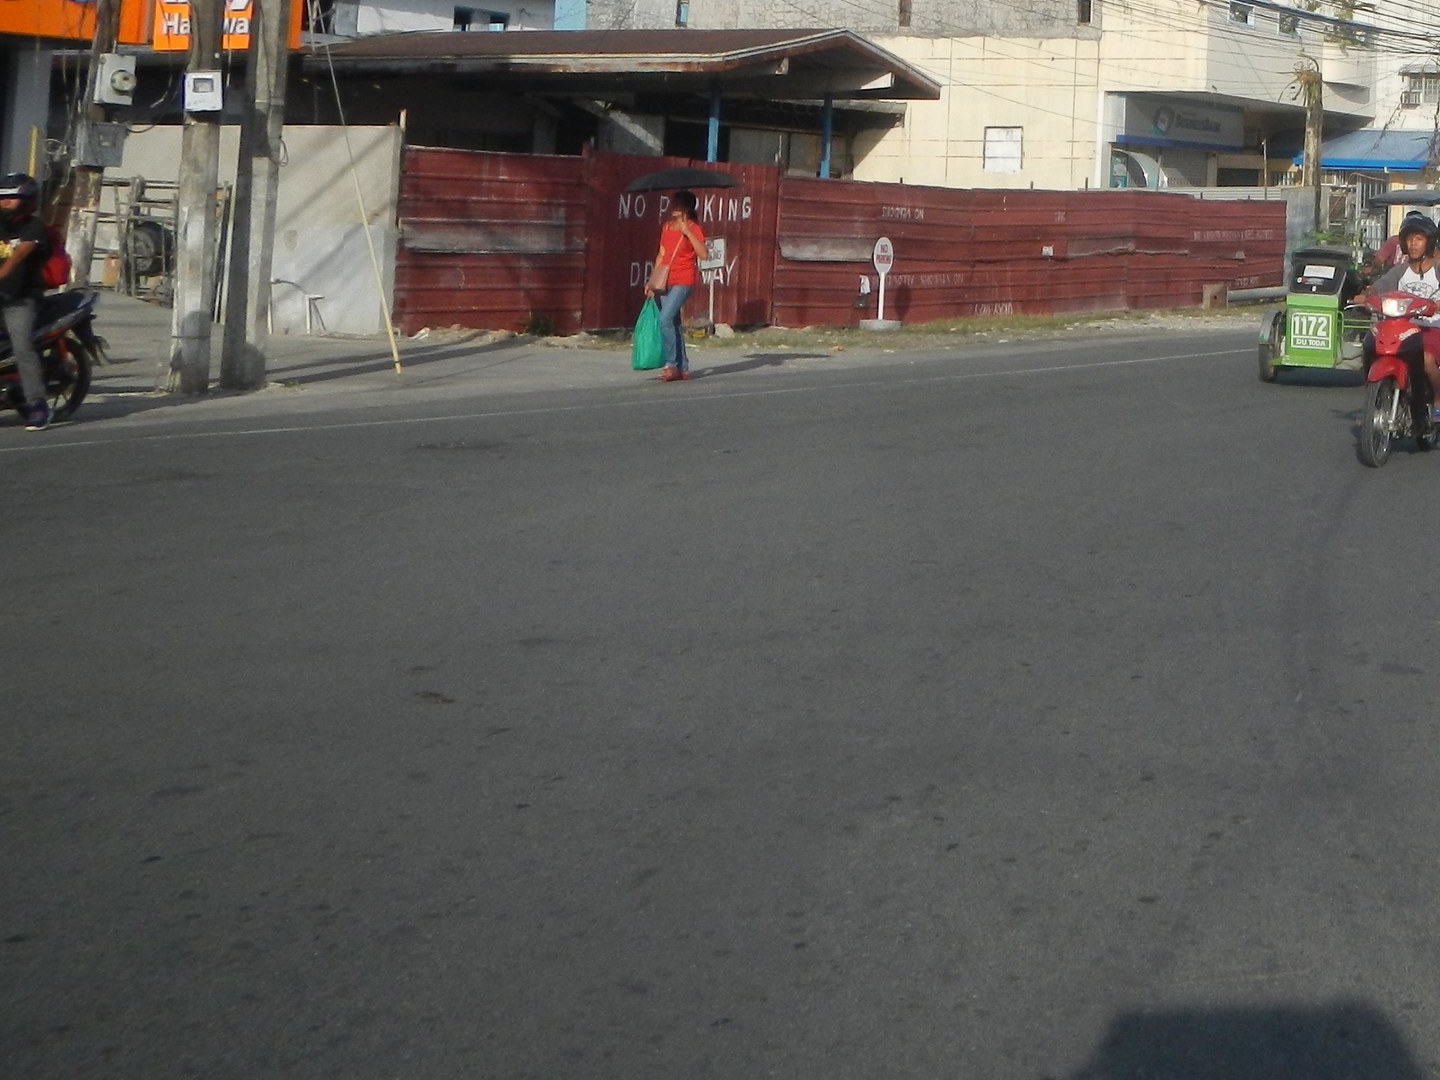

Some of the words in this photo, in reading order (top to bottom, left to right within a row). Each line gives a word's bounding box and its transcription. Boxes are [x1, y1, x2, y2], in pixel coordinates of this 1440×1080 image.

[618, 194, 646, 220] NO
[659, 196, 751, 224] PKING
[880, 244, 889, 254] NO
[875, 255, 892, 265] PARKING
[1293, 315, 1328, 337] 1172
[1308, 339, 1327, 348] TODA
